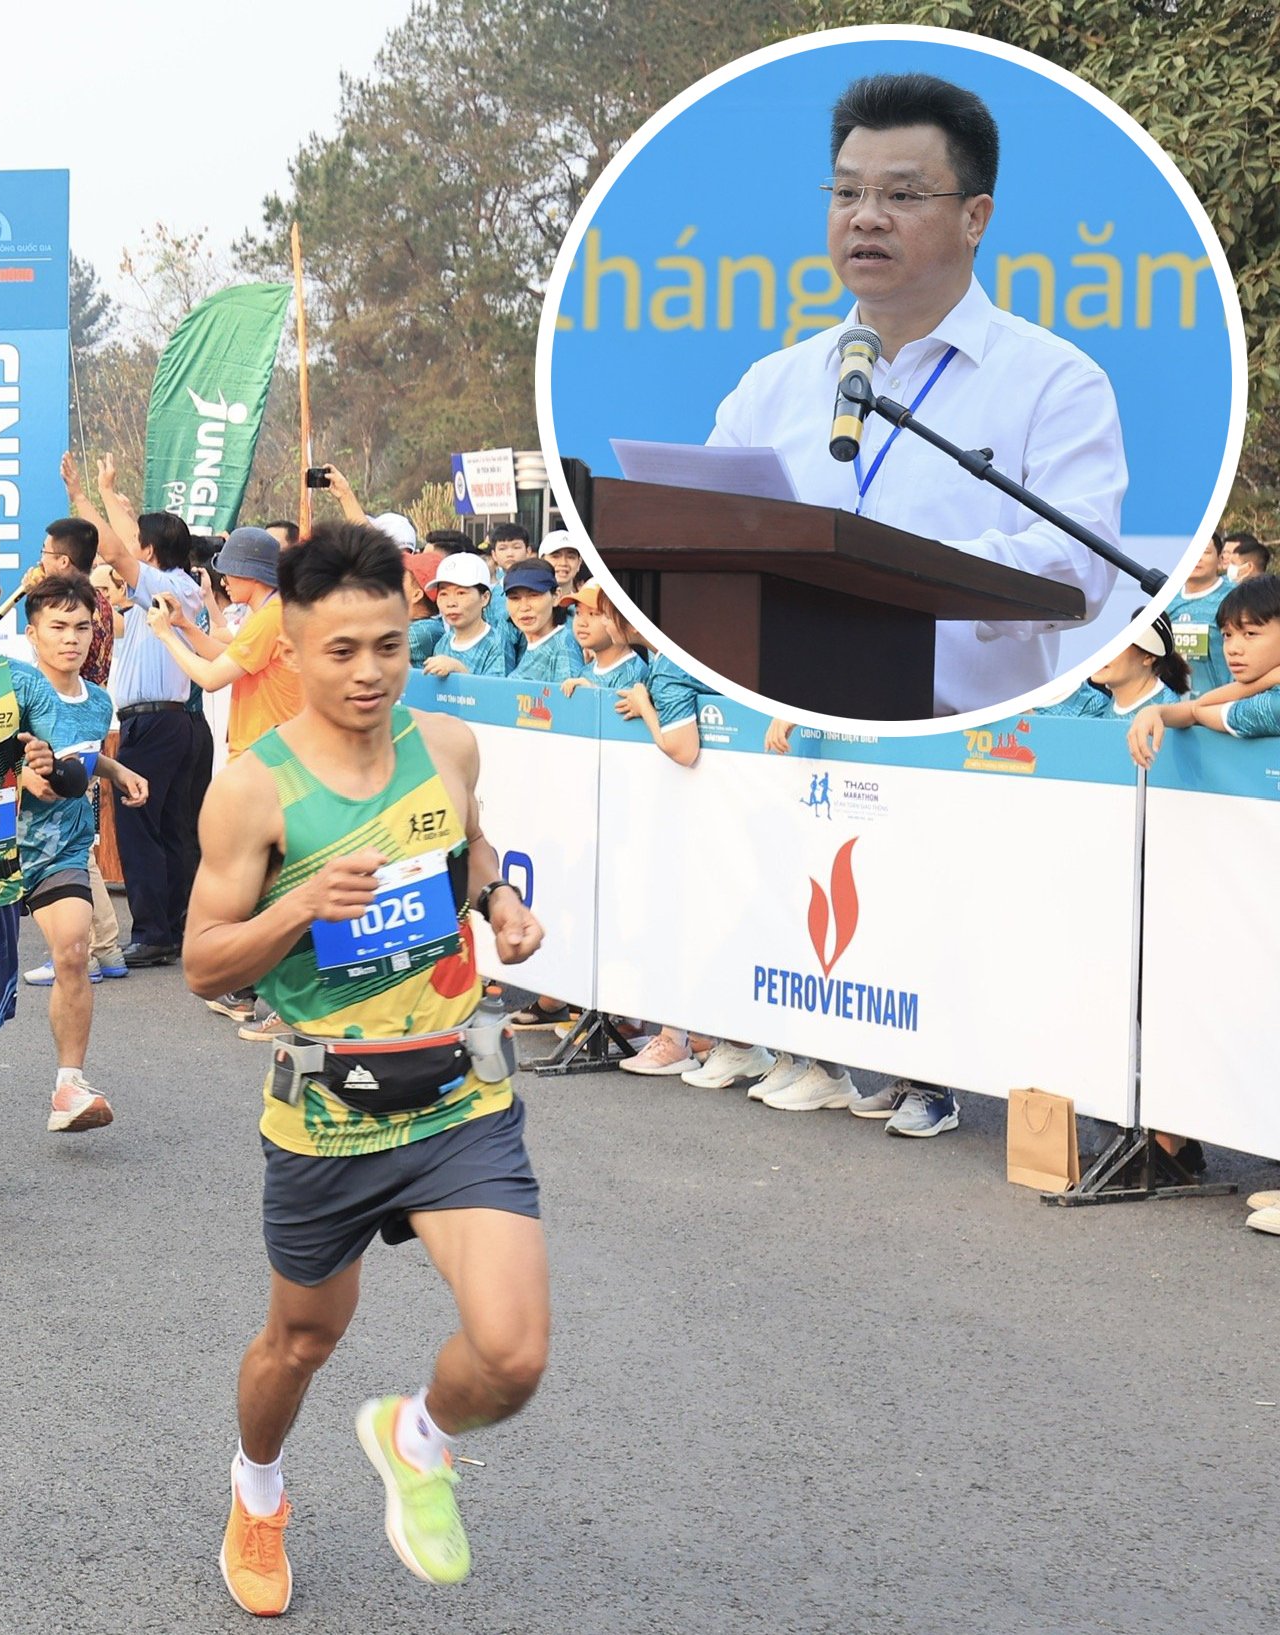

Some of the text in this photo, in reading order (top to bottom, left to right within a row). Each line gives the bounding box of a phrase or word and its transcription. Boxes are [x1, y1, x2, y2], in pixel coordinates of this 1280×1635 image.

[995, 220, 1228, 330] năm
[187, 386, 248, 537] JUNGL
[1174, 634, 1198, 646] 095
[962, 730, 993, 752] 70
[844, 780, 879, 792] THACO
[844, 791, 879, 802] MARATHON
[421, 809, 447, 832] 27
[350, 890, 426, 938] 1026
[753, 965, 919, 1033] PETROVIETNAM
